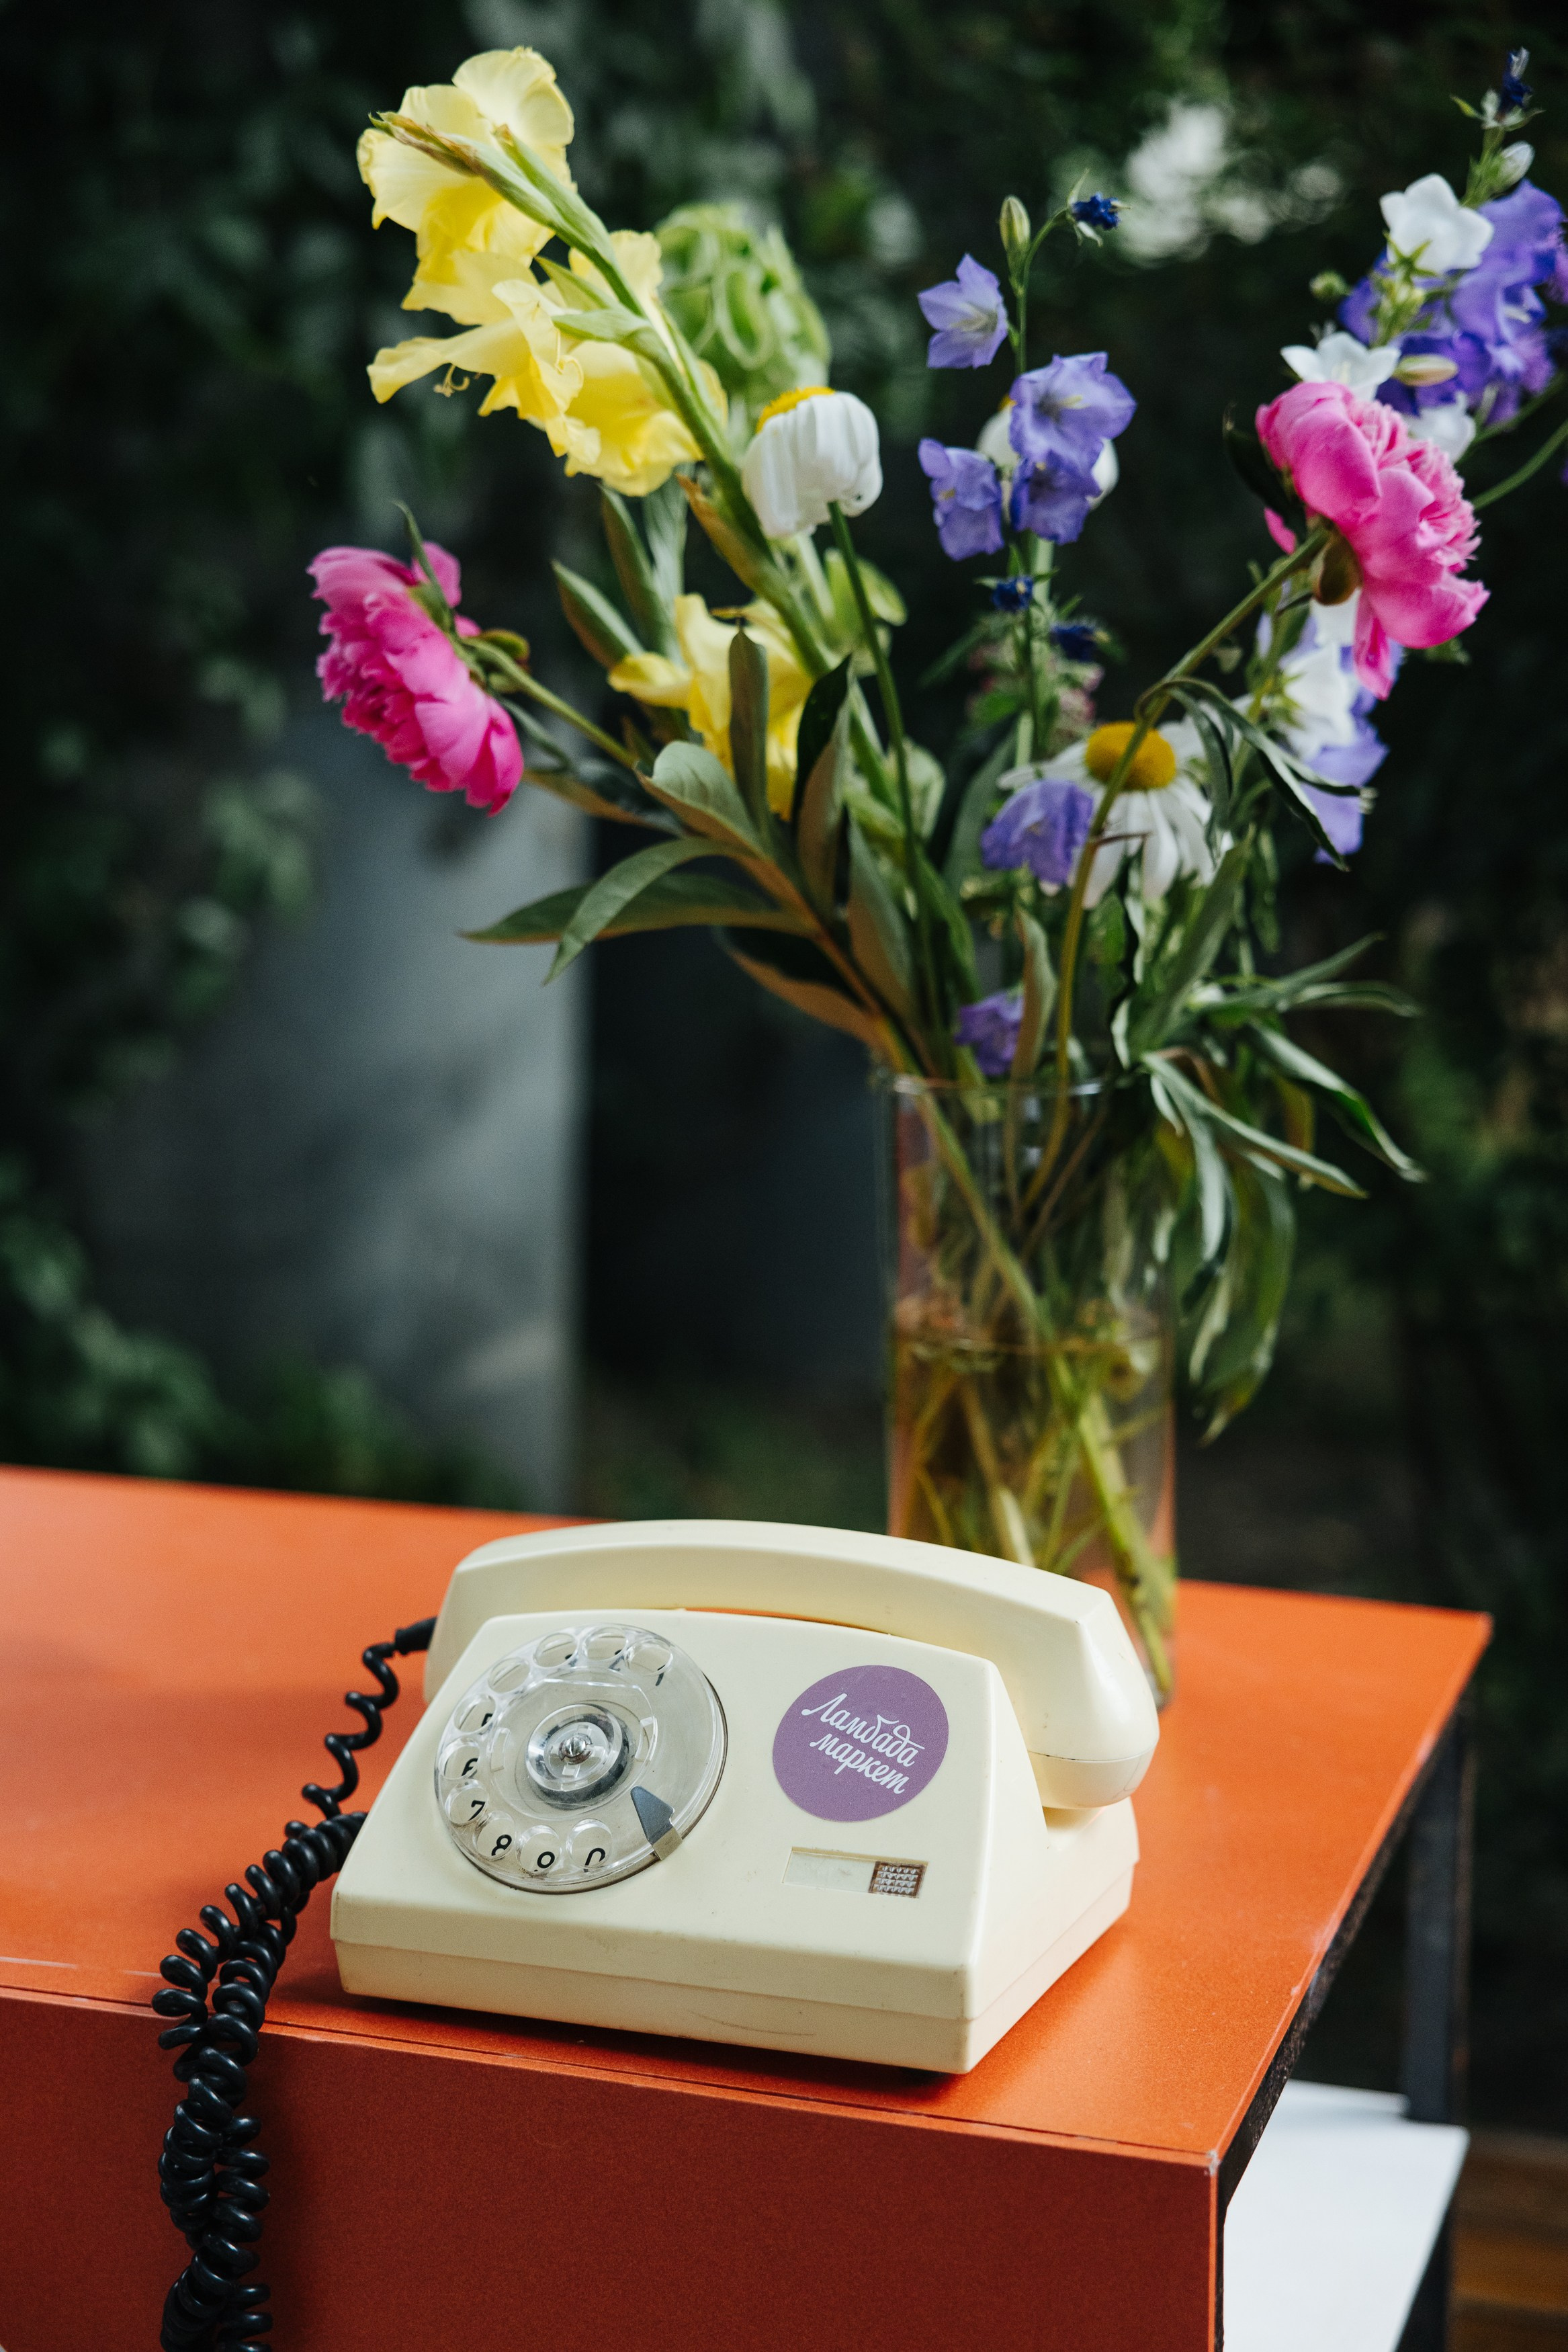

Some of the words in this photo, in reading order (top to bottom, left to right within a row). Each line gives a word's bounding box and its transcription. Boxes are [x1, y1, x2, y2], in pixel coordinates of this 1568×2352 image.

[801, 1693, 925, 1767] Ламбада
[810, 1734, 910, 1794] маркет
[468, 1800, 486, 1821] 7
[491, 1834, 513, 1857] 8
